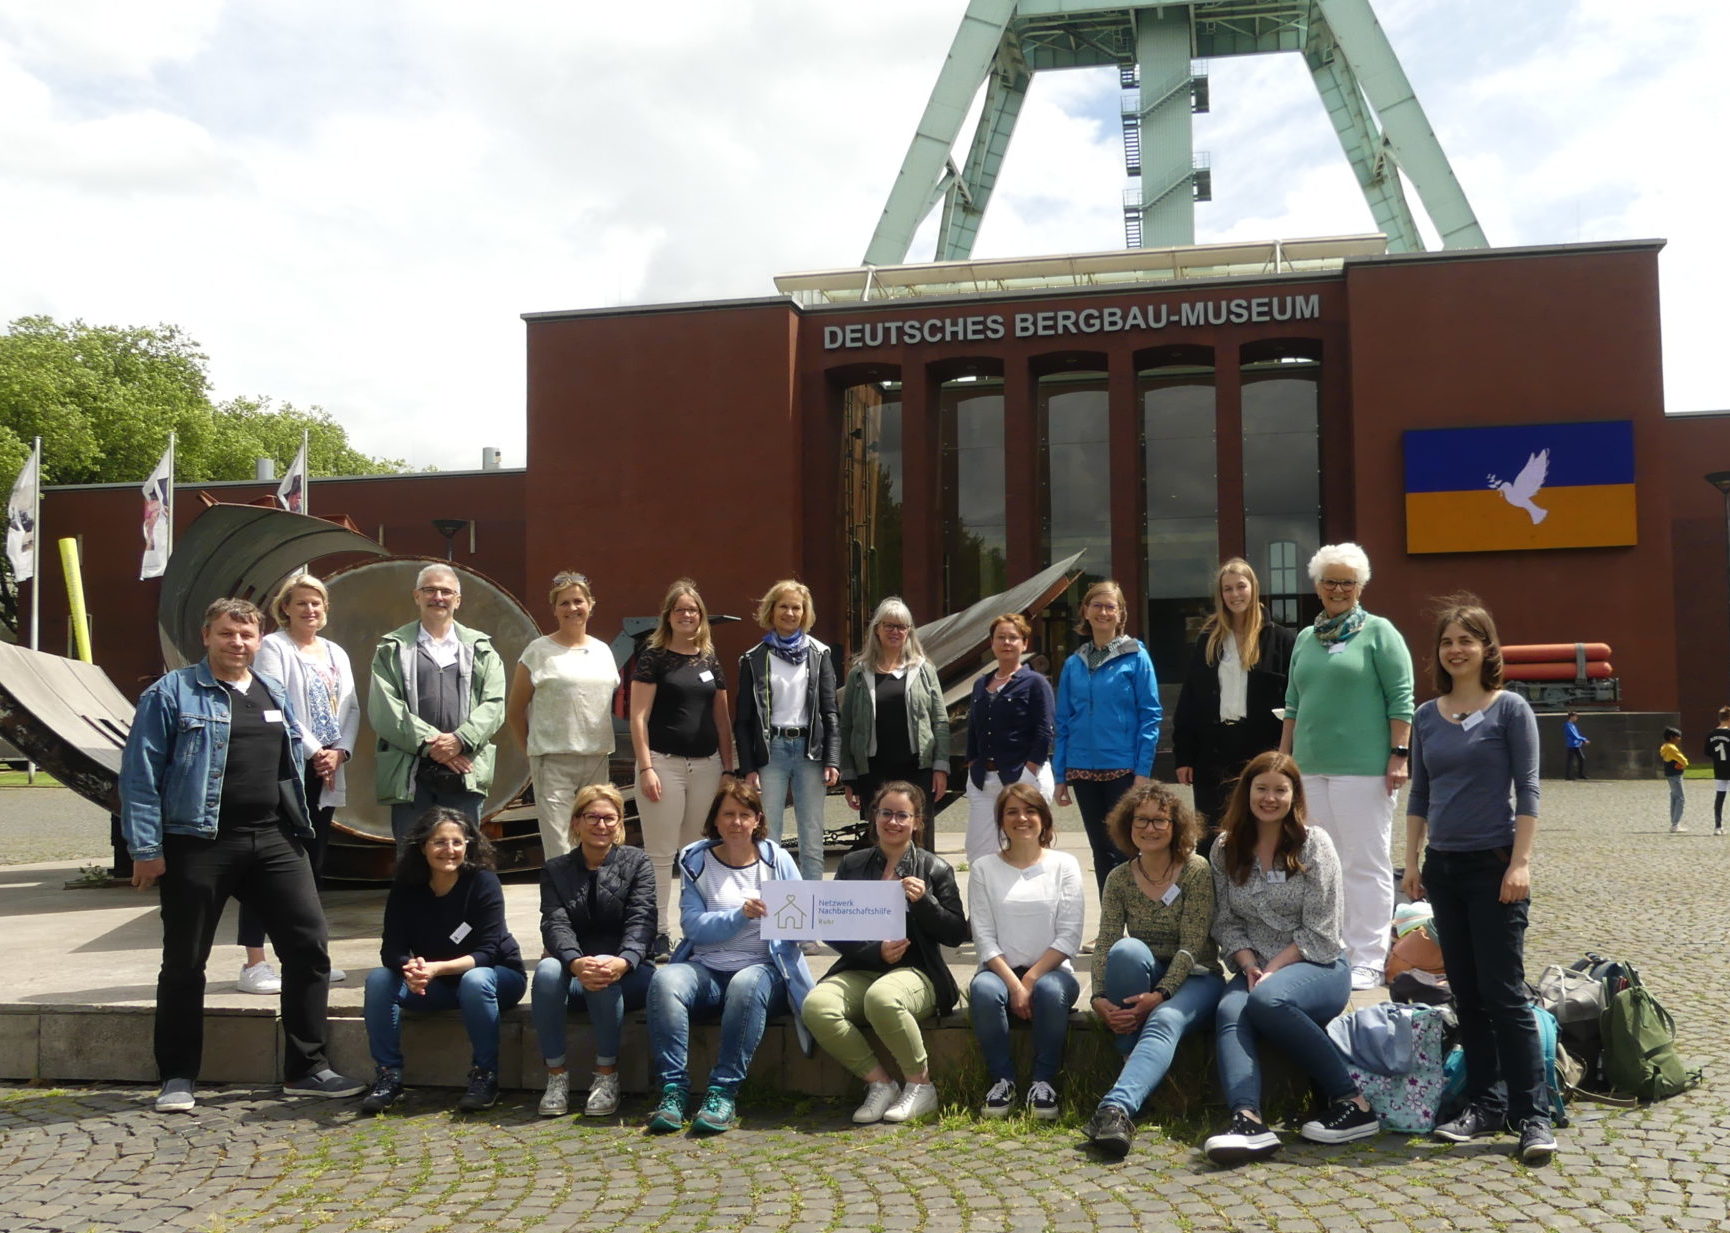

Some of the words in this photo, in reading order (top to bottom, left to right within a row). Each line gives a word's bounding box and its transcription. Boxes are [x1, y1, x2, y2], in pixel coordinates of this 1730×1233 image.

[823, 314, 1005, 350] DEUTSCHES
[1015, 294, 1320, 338] BERGBAU-MUSEUM
[818, 907, 892, 915] Nachbarschaftshilfe
